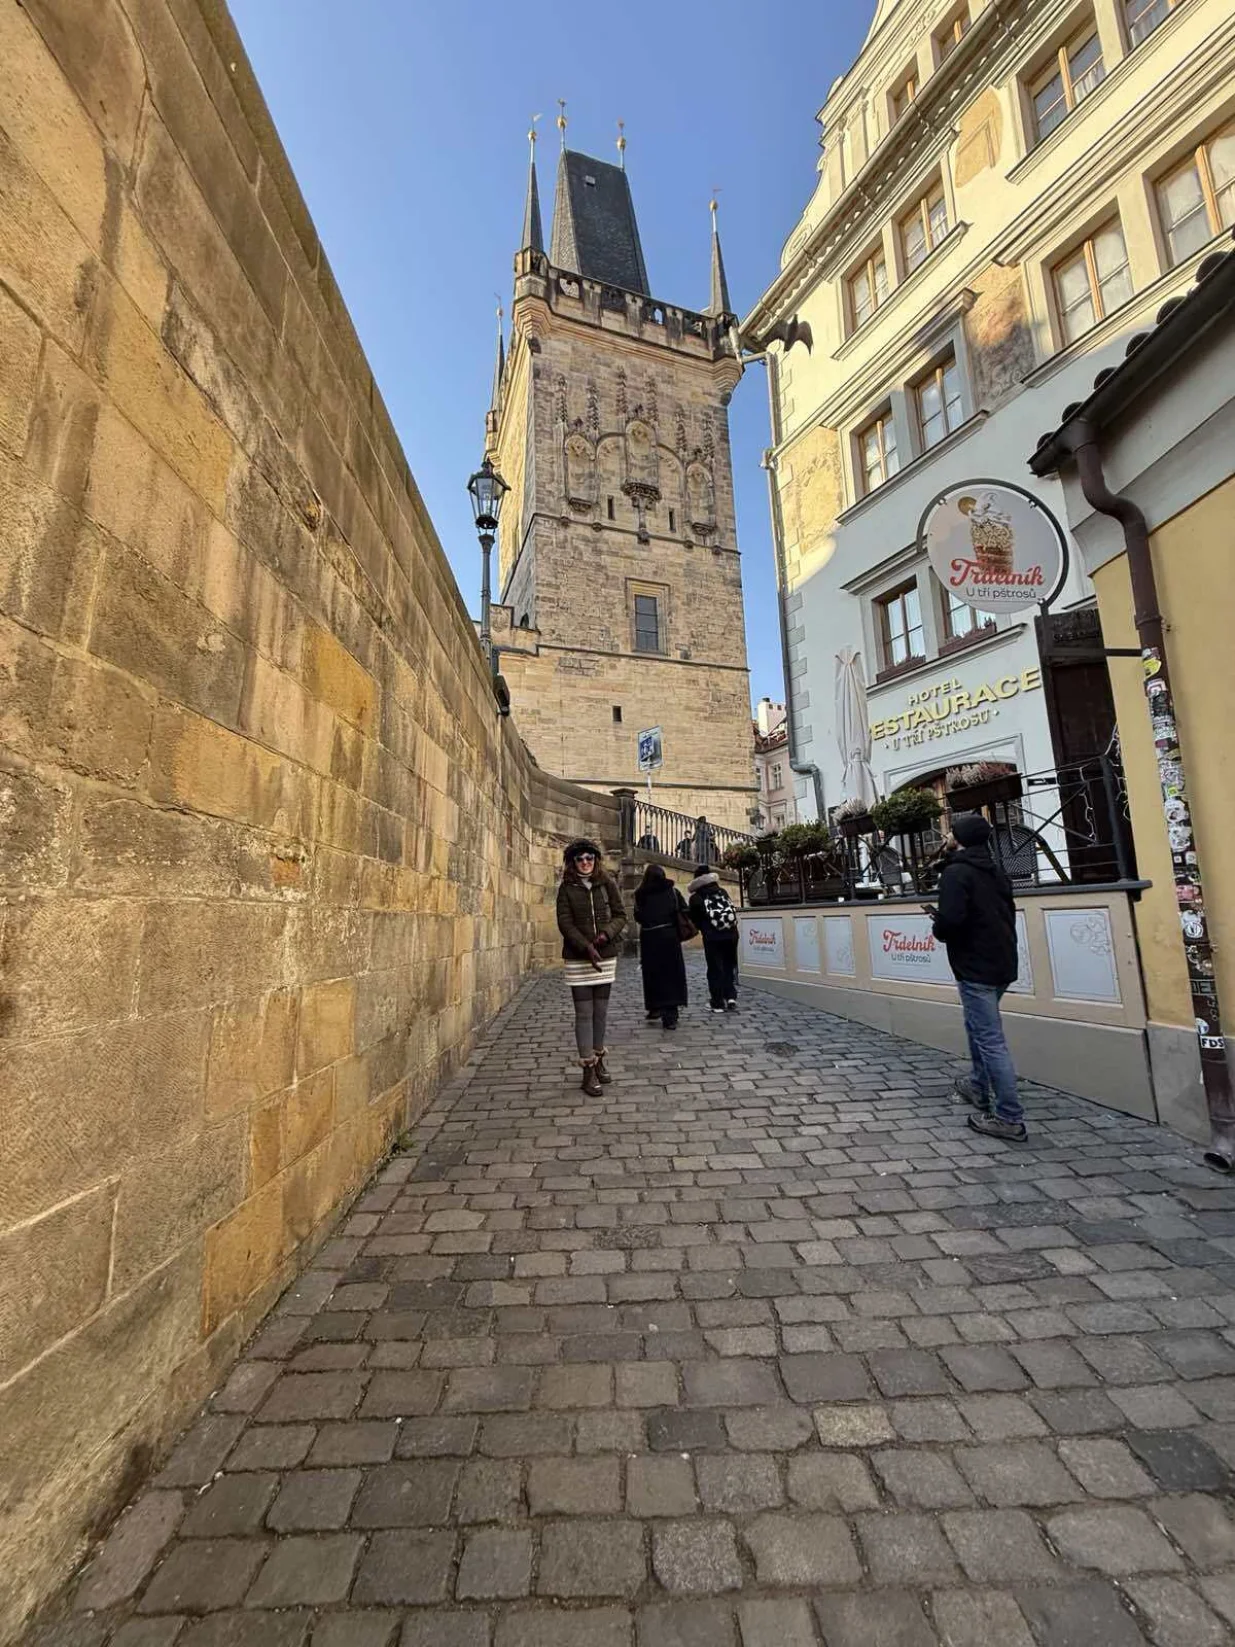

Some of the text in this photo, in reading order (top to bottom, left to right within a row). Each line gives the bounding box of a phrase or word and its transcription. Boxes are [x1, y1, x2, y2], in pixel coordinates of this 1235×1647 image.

[966, 588, 975, 597] U
[993, 588, 1036, 598] pštrosů
[869, 666, 1042, 740] ESTAURACE
[909, 677, 963, 706] HOTEL
[892, 737, 901, 751] U
[883, 929, 936, 952] Trdelník
